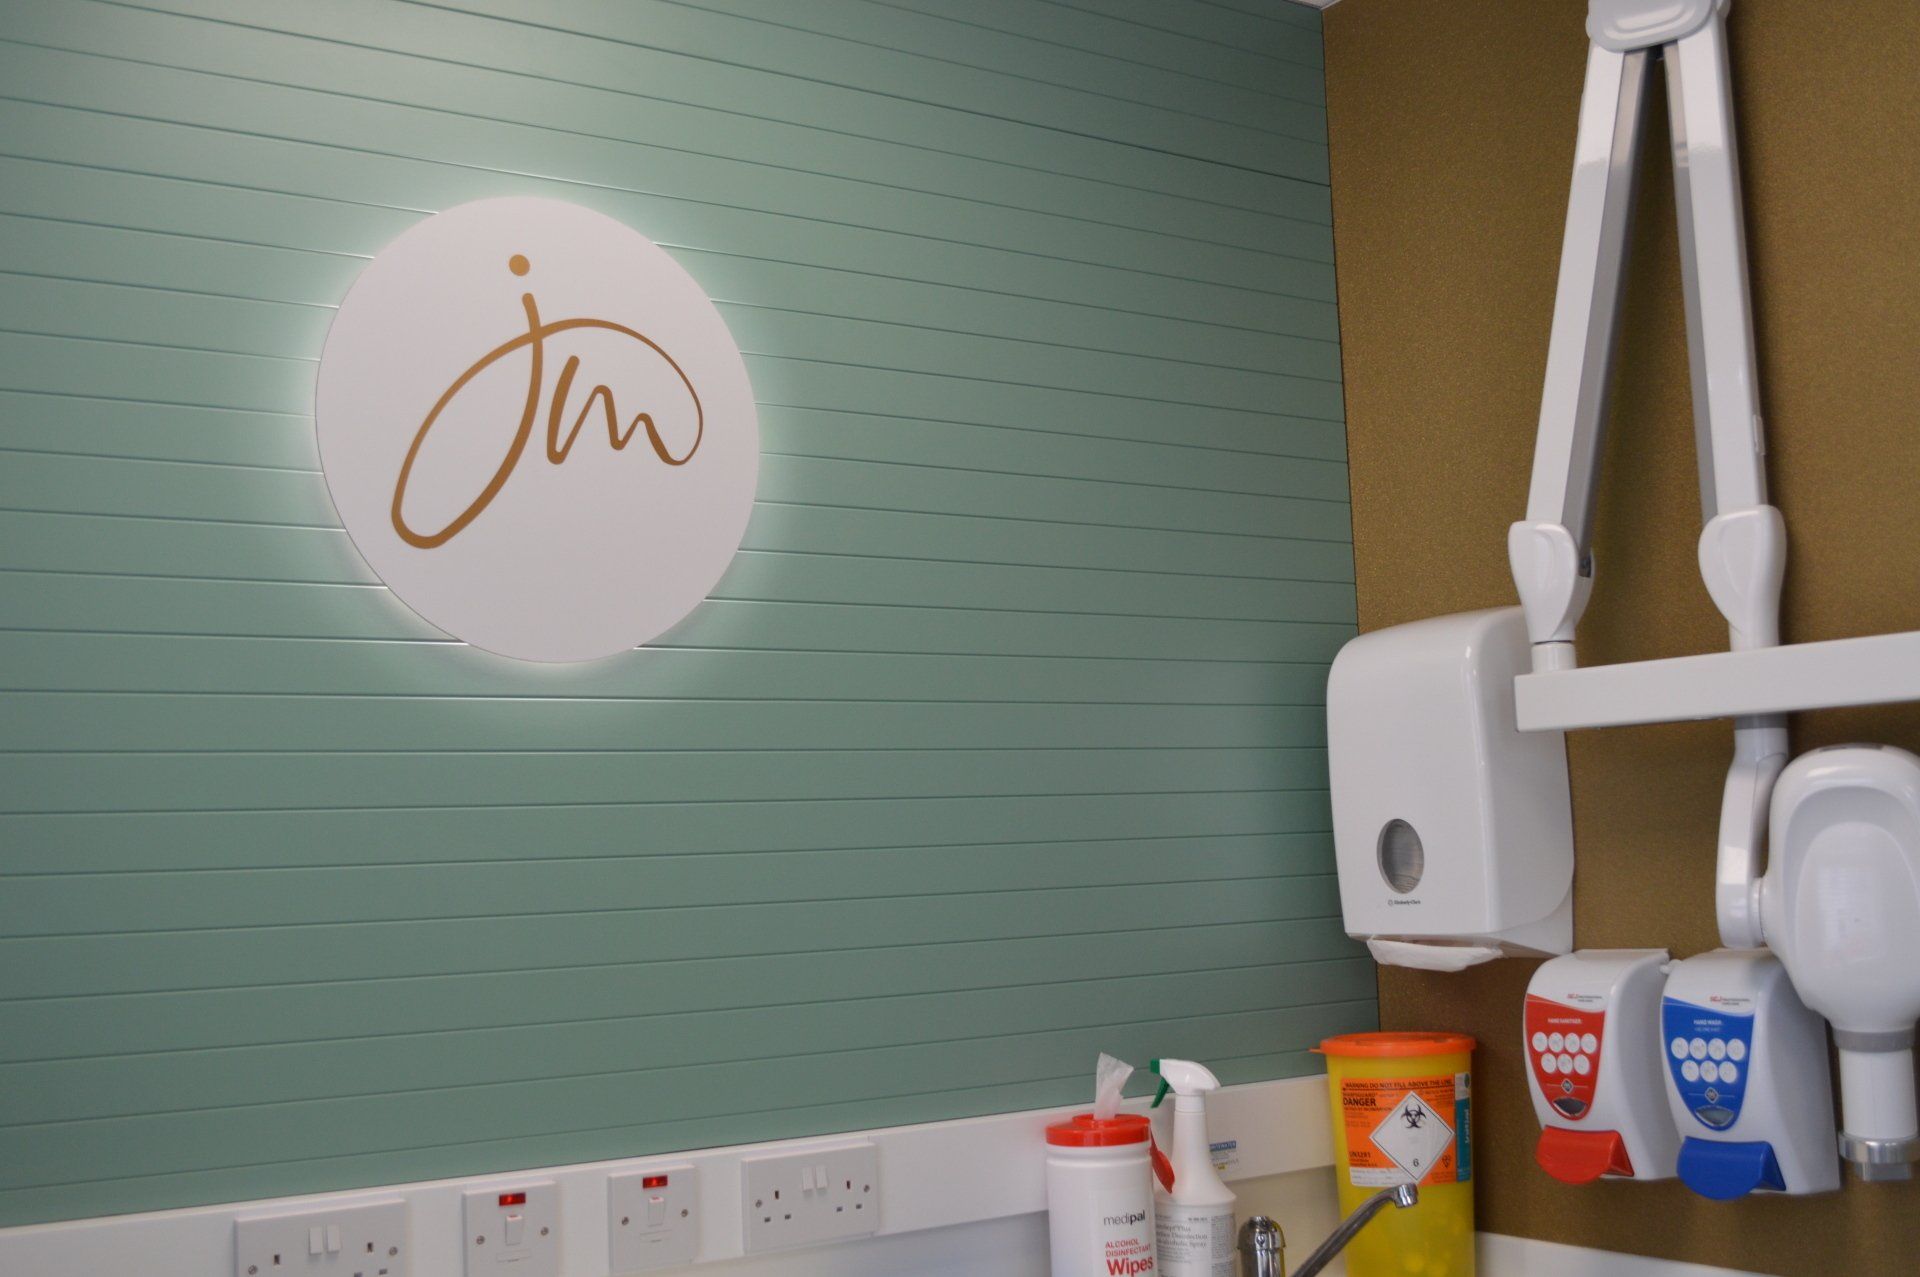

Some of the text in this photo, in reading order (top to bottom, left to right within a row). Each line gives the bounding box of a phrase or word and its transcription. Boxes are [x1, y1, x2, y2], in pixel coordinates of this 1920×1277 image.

[1343, 1098, 1376, 1107] DANGER
[1413, 1158, 1419, 1167] 6
[1103, 1210, 1146, 1225] medipal
[1105, 1238, 1140, 1249] ALCOHOL
[1105, 1243, 1151, 1257] DISINFECTANT
[1106, 1257, 1153, 1277] Wipes
